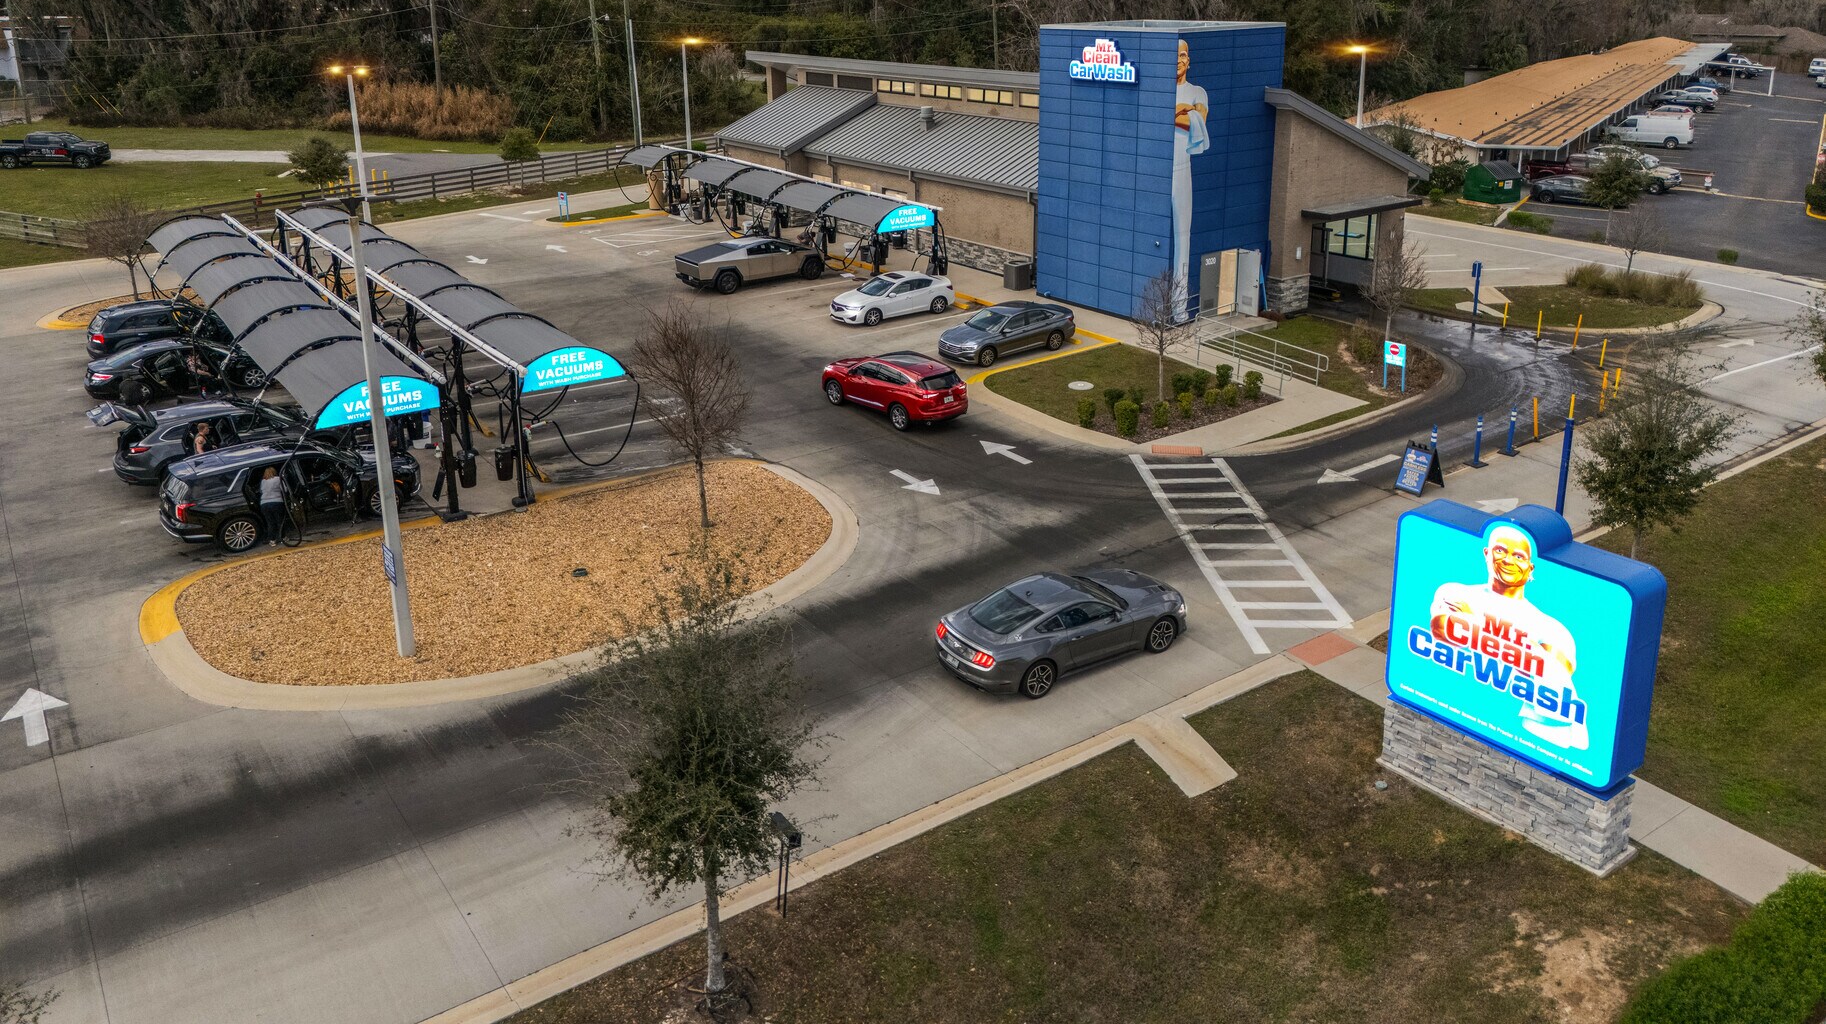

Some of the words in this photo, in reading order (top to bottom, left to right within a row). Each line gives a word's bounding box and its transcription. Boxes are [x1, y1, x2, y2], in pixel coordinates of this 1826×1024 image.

[1096, 43, 1113, 52] Mr.
[1084, 50, 1118, 64] Clean
[1070, 63, 1132, 80] CarWash
[890, 214, 926, 225] VACUUMS
[898, 208, 918, 216] FREE
[552, 352, 586, 366] FREE
[536, 360, 604, 380] VACUUMS
[361, 380, 402, 396] FEE
[1482, 612, 1532, 650] Mr.
[1446, 614, 1544, 678] Clean
[1409, 627, 1586, 726] CarWash
